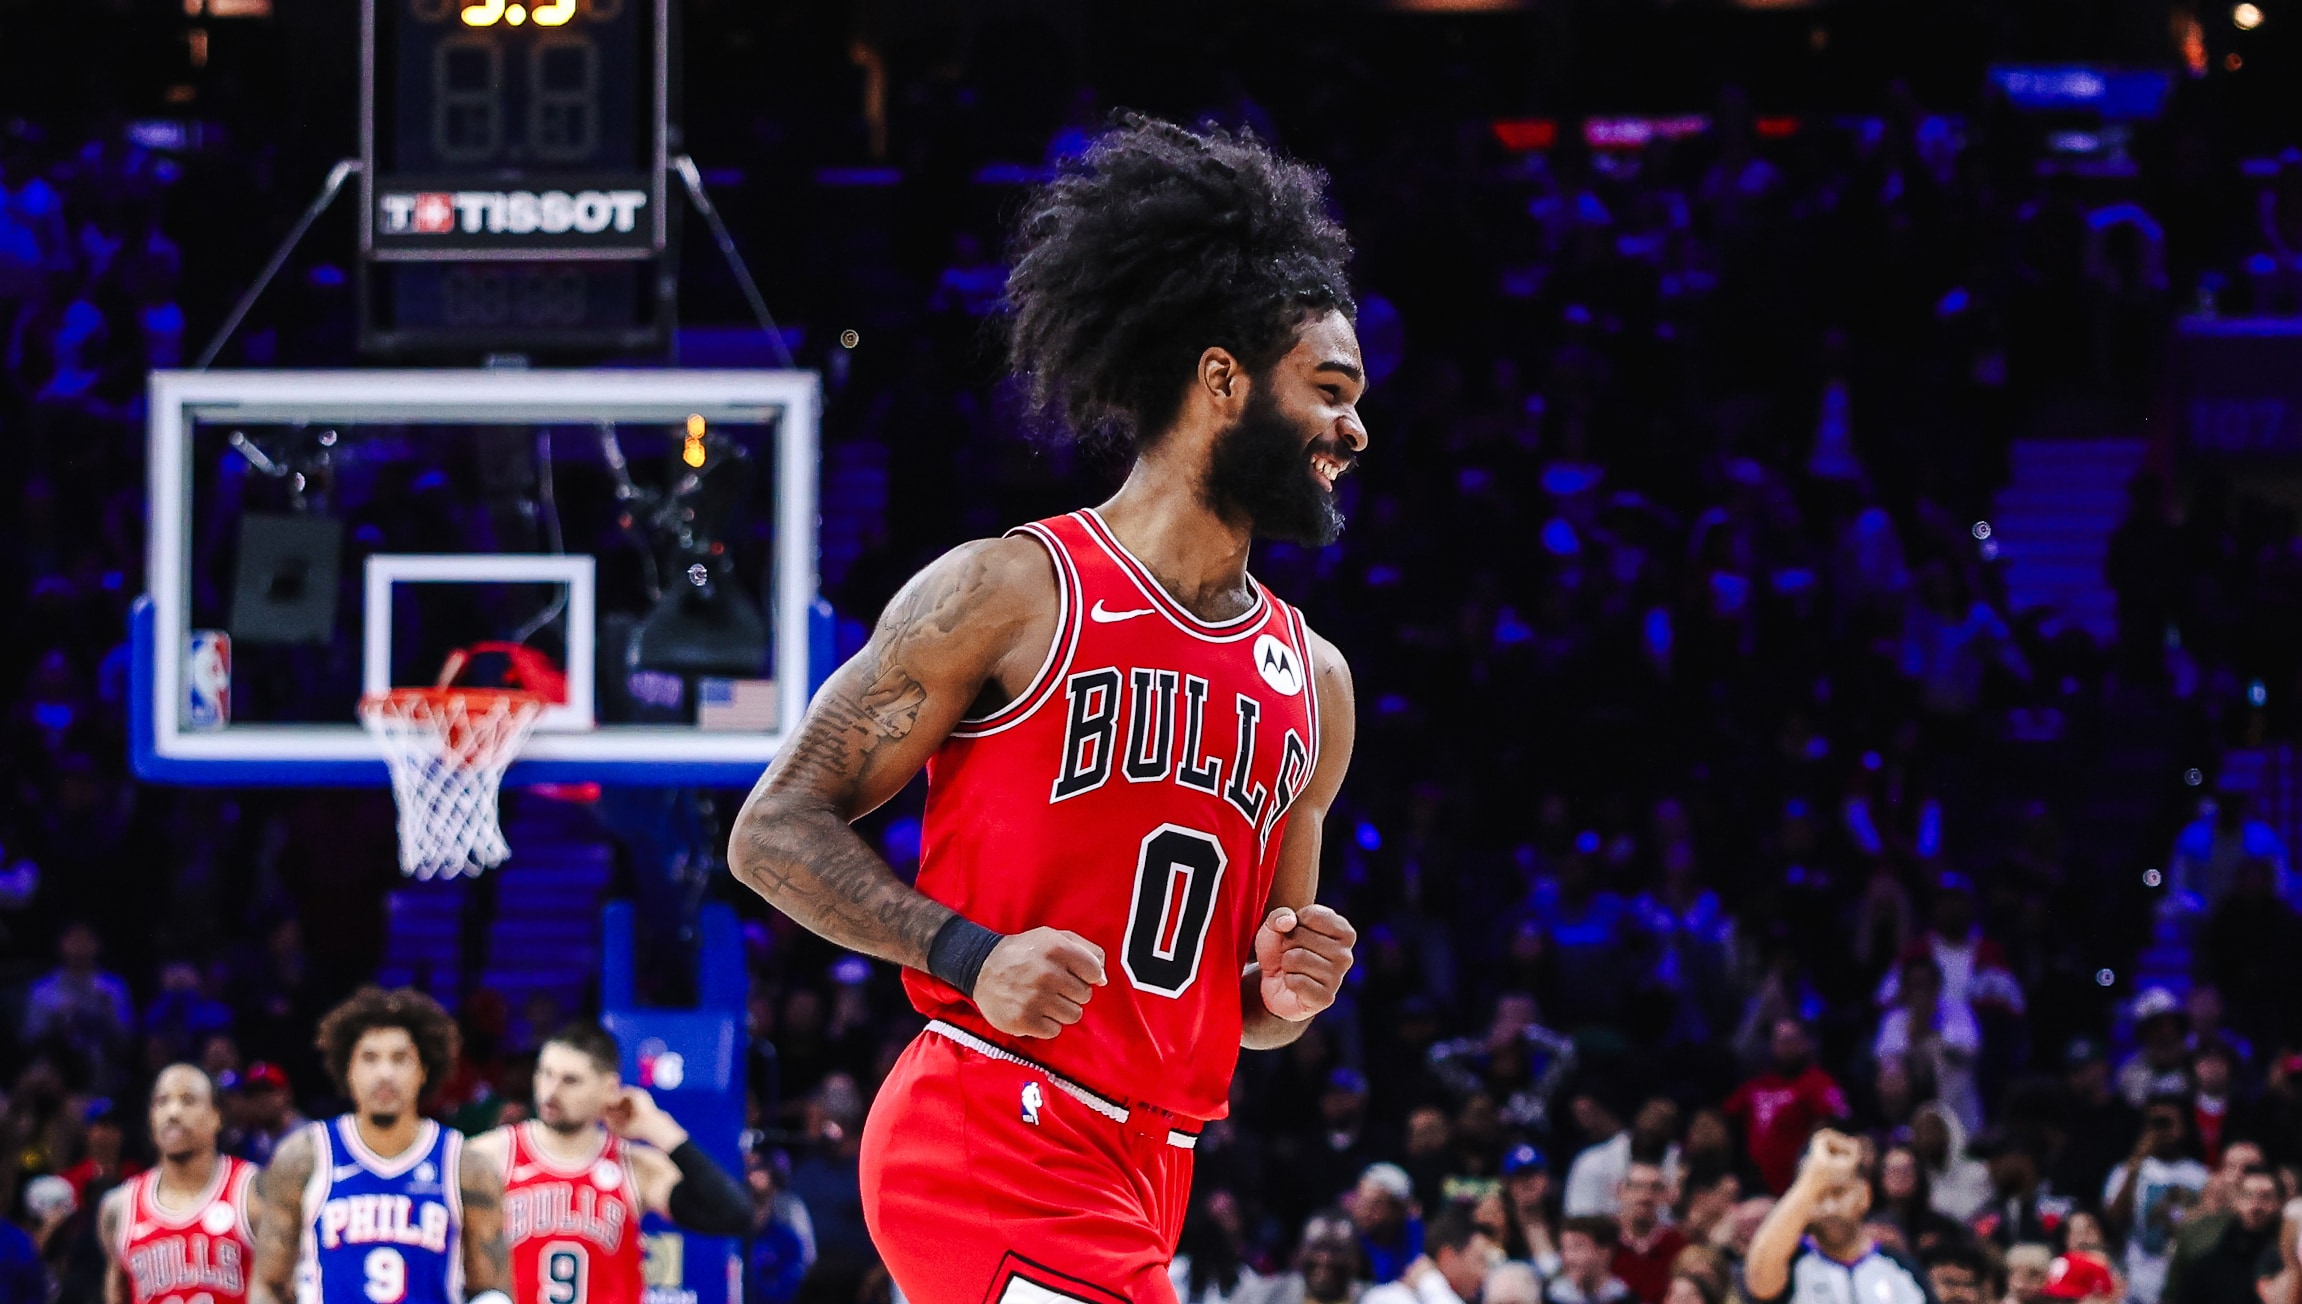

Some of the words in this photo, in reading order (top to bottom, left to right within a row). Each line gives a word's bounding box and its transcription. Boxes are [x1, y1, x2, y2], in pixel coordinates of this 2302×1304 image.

[455, 190, 647, 233] TISSOT
[1120, 822, 1228, 1000] 0
[505, 1181, 627, 1256] BULLS
[129, 1233, 244, 1303] BULLS
[364, 1247, 409, 1304] 9
[538, 1240, 589, 1304] 9
